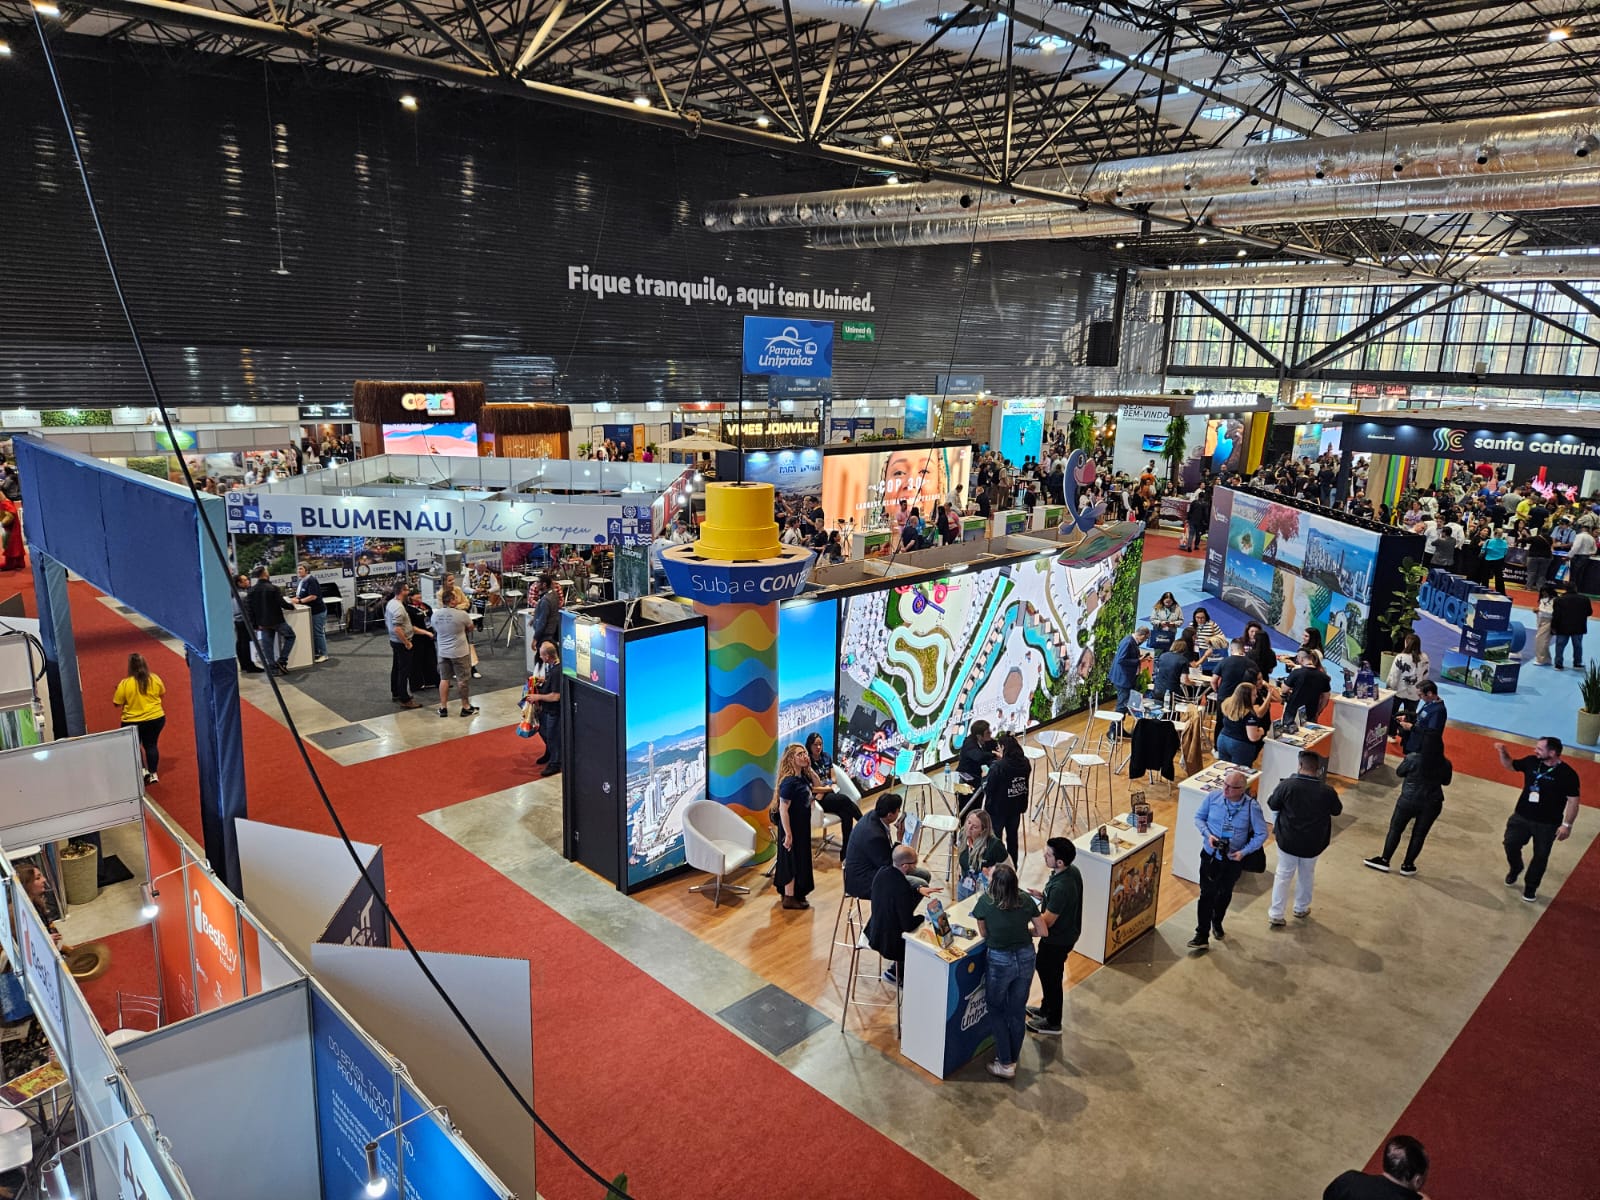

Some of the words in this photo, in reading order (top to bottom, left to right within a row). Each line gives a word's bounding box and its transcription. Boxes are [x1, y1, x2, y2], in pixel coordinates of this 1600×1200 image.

[568, 265, 631, 300] Fique
[635, 273, 733, 306] tranquilo,
[736, 282, 775, 310] aqui
[778, 287, 809, 308] tem
[813, 288, 875, 313] Unimed.
[845, 326, 866, 334] Unimed
[768, 345, 802, 356] Parque
[758, 354, 813, 369] Unipraias
[401, 391, 455, 412] ceará
[1194, 395, 1208, 408] RIO
[1209, 394, 1236, 407] GRANDE
[1236, 394, 1246, 406] DO
[1122, 409, 1171, 420] BEM-VINDO
[765, 421, 819, 435] JOINVILLE
[1474, 436, 1524, 451] santa
[879, 479, 902, 493] COP
[301, 506, 458, 536] BLUMENAU,
[461, 504, 507, 537] Vale
[516, 507, 592, 540] Europeu
[691, 574, 739, 595] Suba
[743, 580, 755, 592] e
[877, 732, 905, 752] Realize
[328, 1035, 340, 1057] DO
[341, 1049, 367, 1088] BRASIL
[367, 1079, 392, 1115] TODO
[336, 1059, 353, 1087] PRO
[354, 1078, 384, 1121] MUNDO
